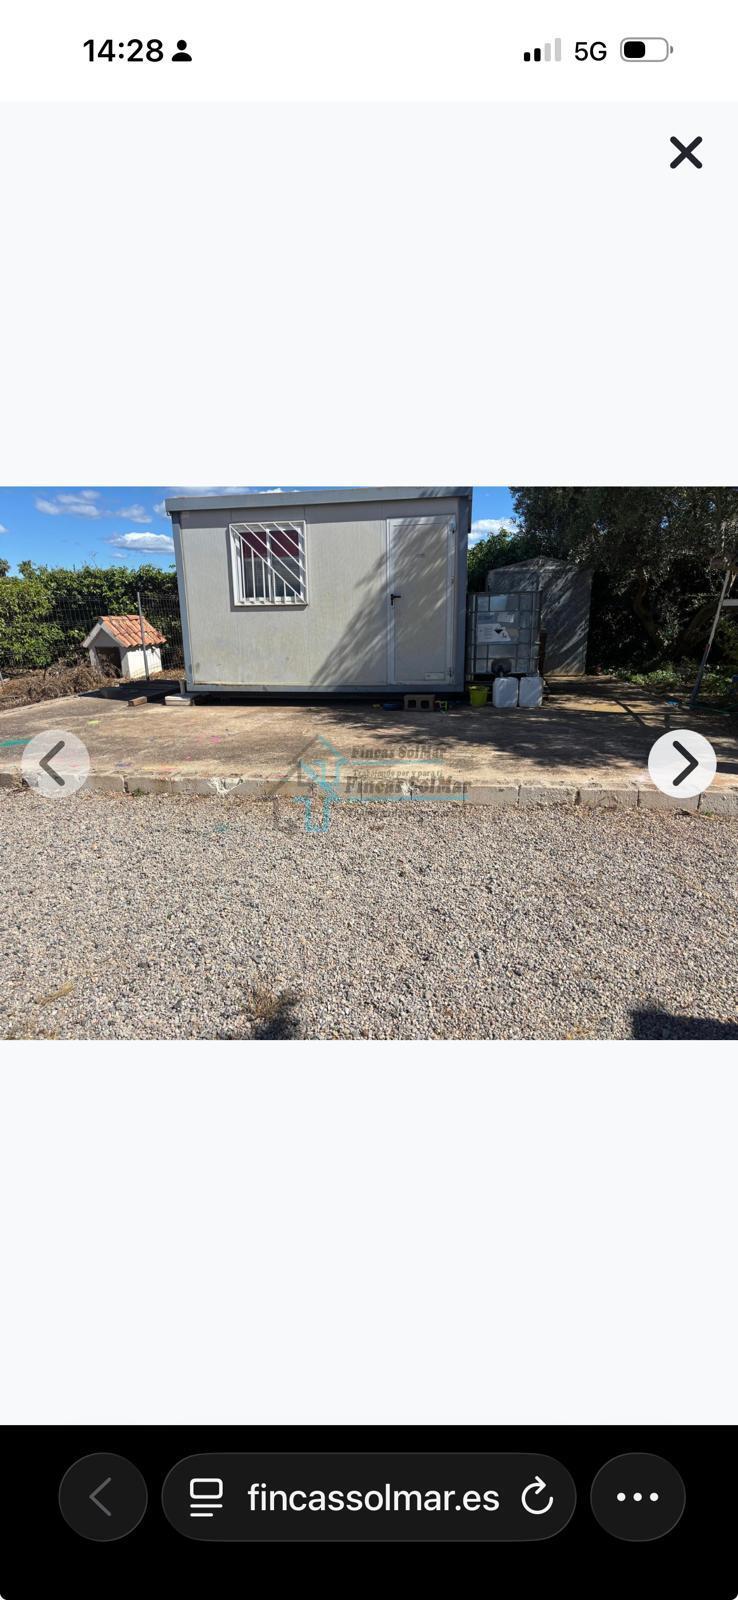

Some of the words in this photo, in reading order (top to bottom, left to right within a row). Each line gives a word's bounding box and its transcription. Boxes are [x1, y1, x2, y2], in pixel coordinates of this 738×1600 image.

[83, 38, 163, 63] 14:28
[574, 41, 607, 62] 5G
[247, 1482, 500, 1512] fincassolmar.es
